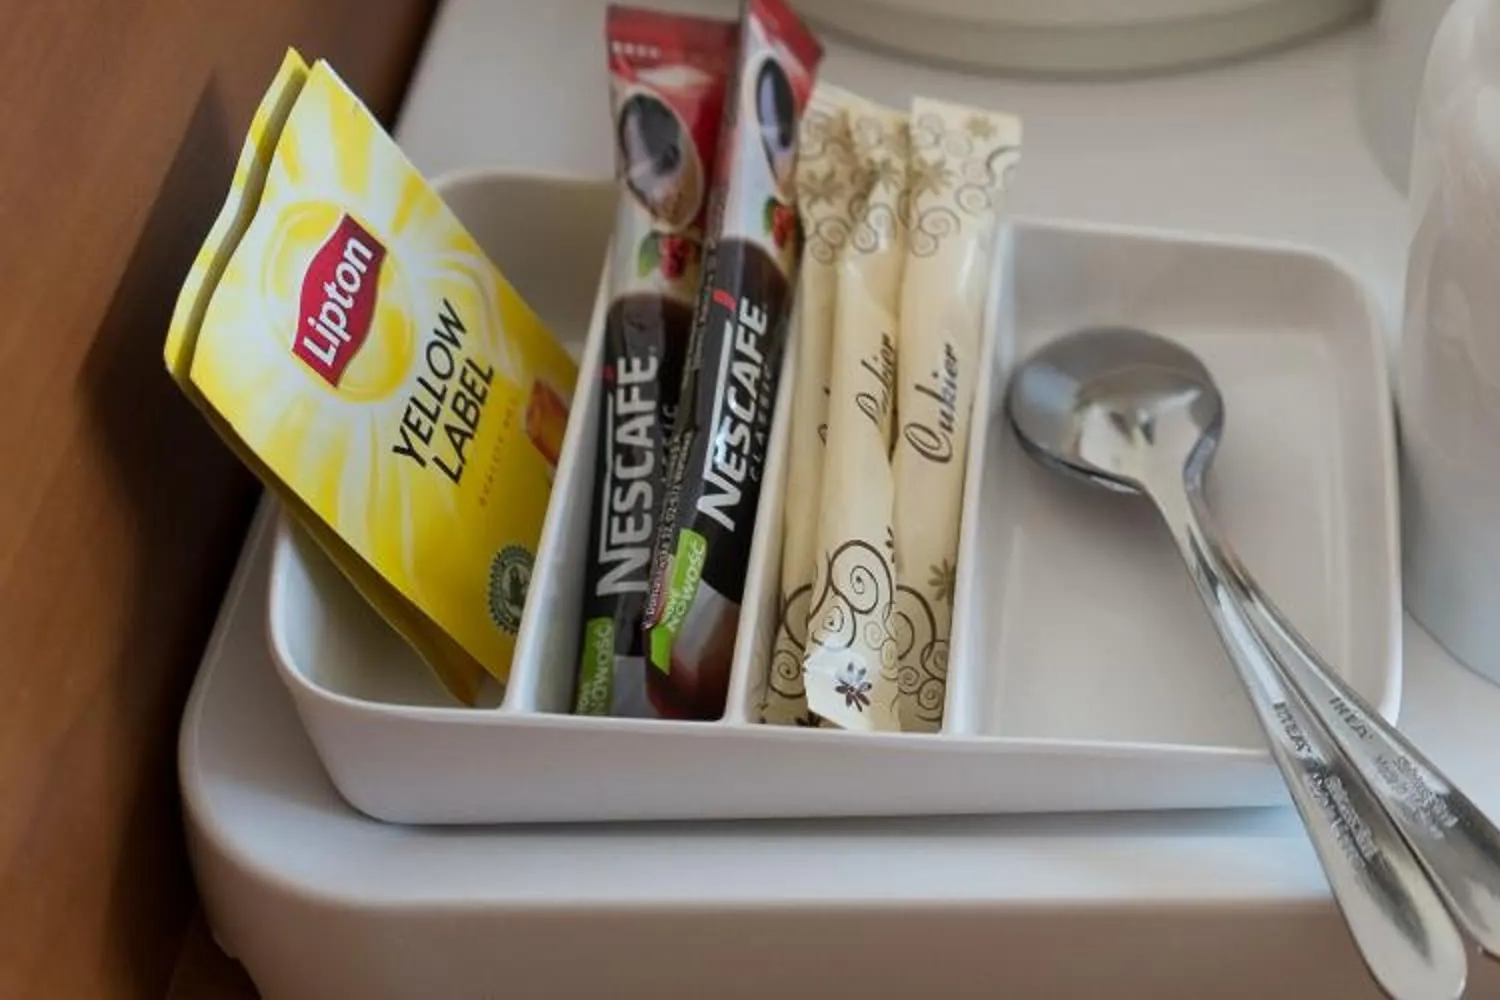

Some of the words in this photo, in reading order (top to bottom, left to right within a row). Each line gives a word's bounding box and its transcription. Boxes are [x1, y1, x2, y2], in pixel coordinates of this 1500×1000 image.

[303, 237, 373, 366] Lipton
[392, 297, 468, 468] YELLOW
[432, 357, 495, 485] LABEL
[903, 341, 958, 464] Cukier
